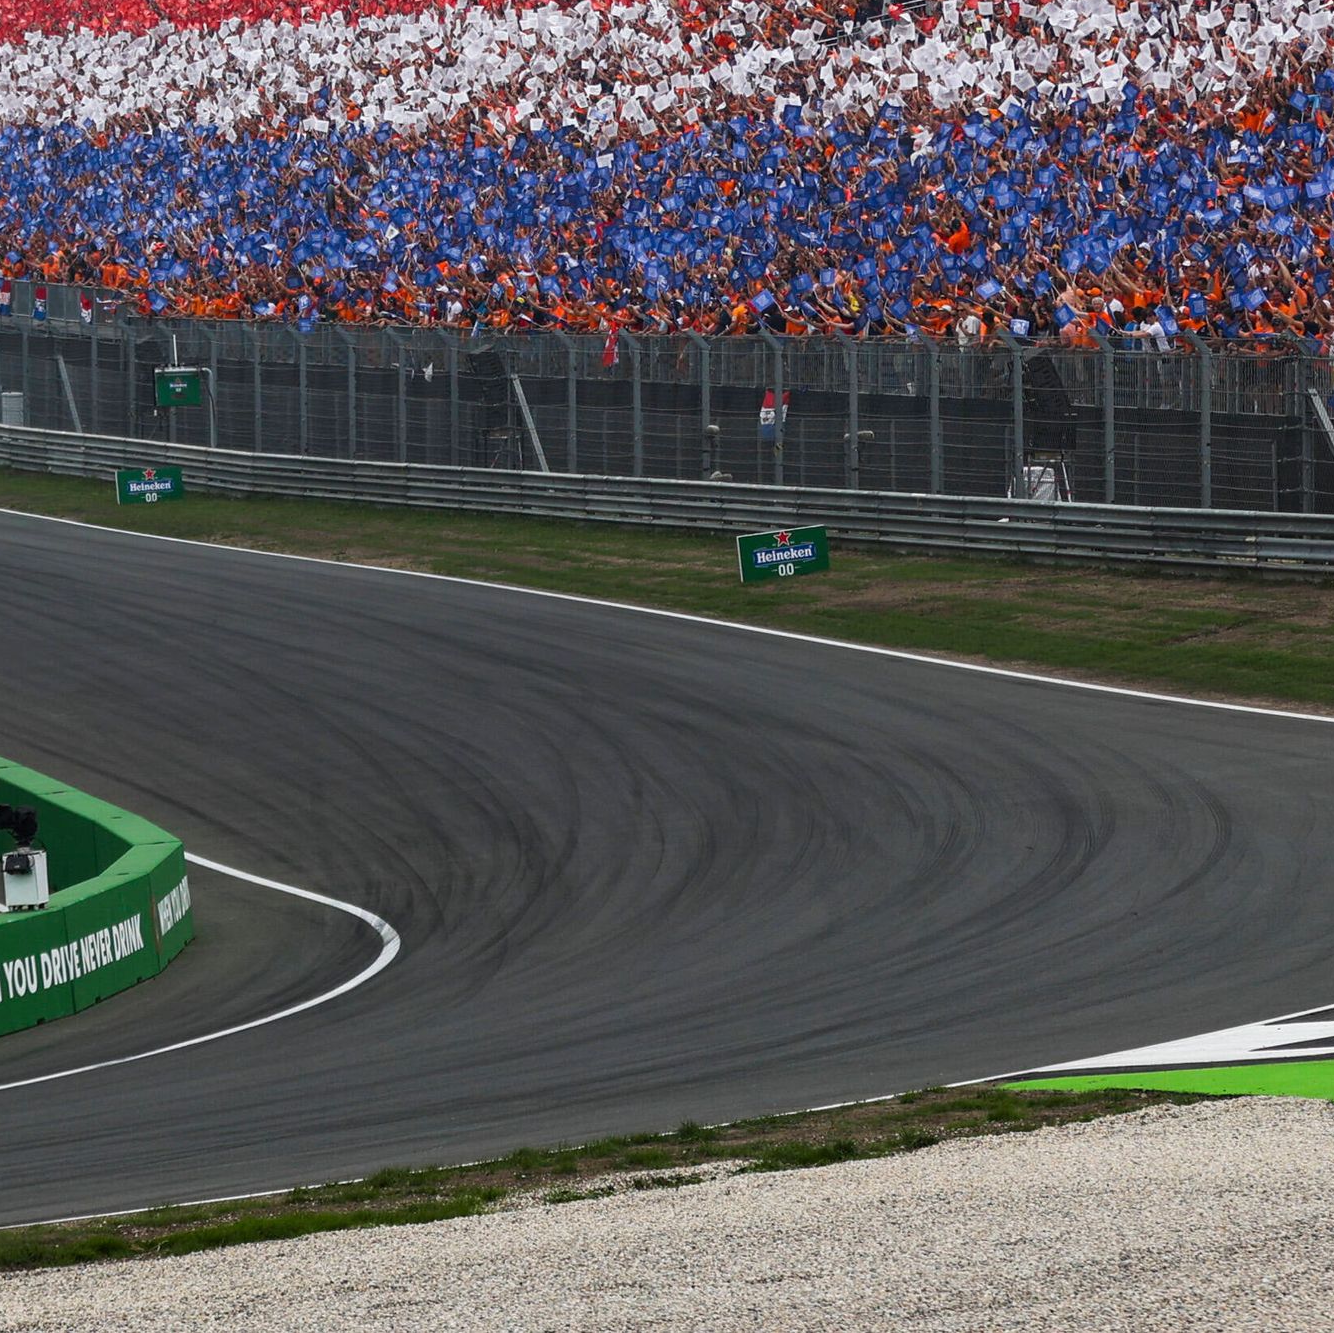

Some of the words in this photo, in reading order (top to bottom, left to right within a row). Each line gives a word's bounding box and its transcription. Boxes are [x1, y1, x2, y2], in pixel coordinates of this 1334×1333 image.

[129, 480, 171, 492] Heineken
[756, 547, 812, 563] Heineken
[3, 955, 37, 999] YOU
[40, 941, 81, 990] DRIVE
[80, 928, 113, 974] NEVER
[113, 913, 144, 961] DRINK
